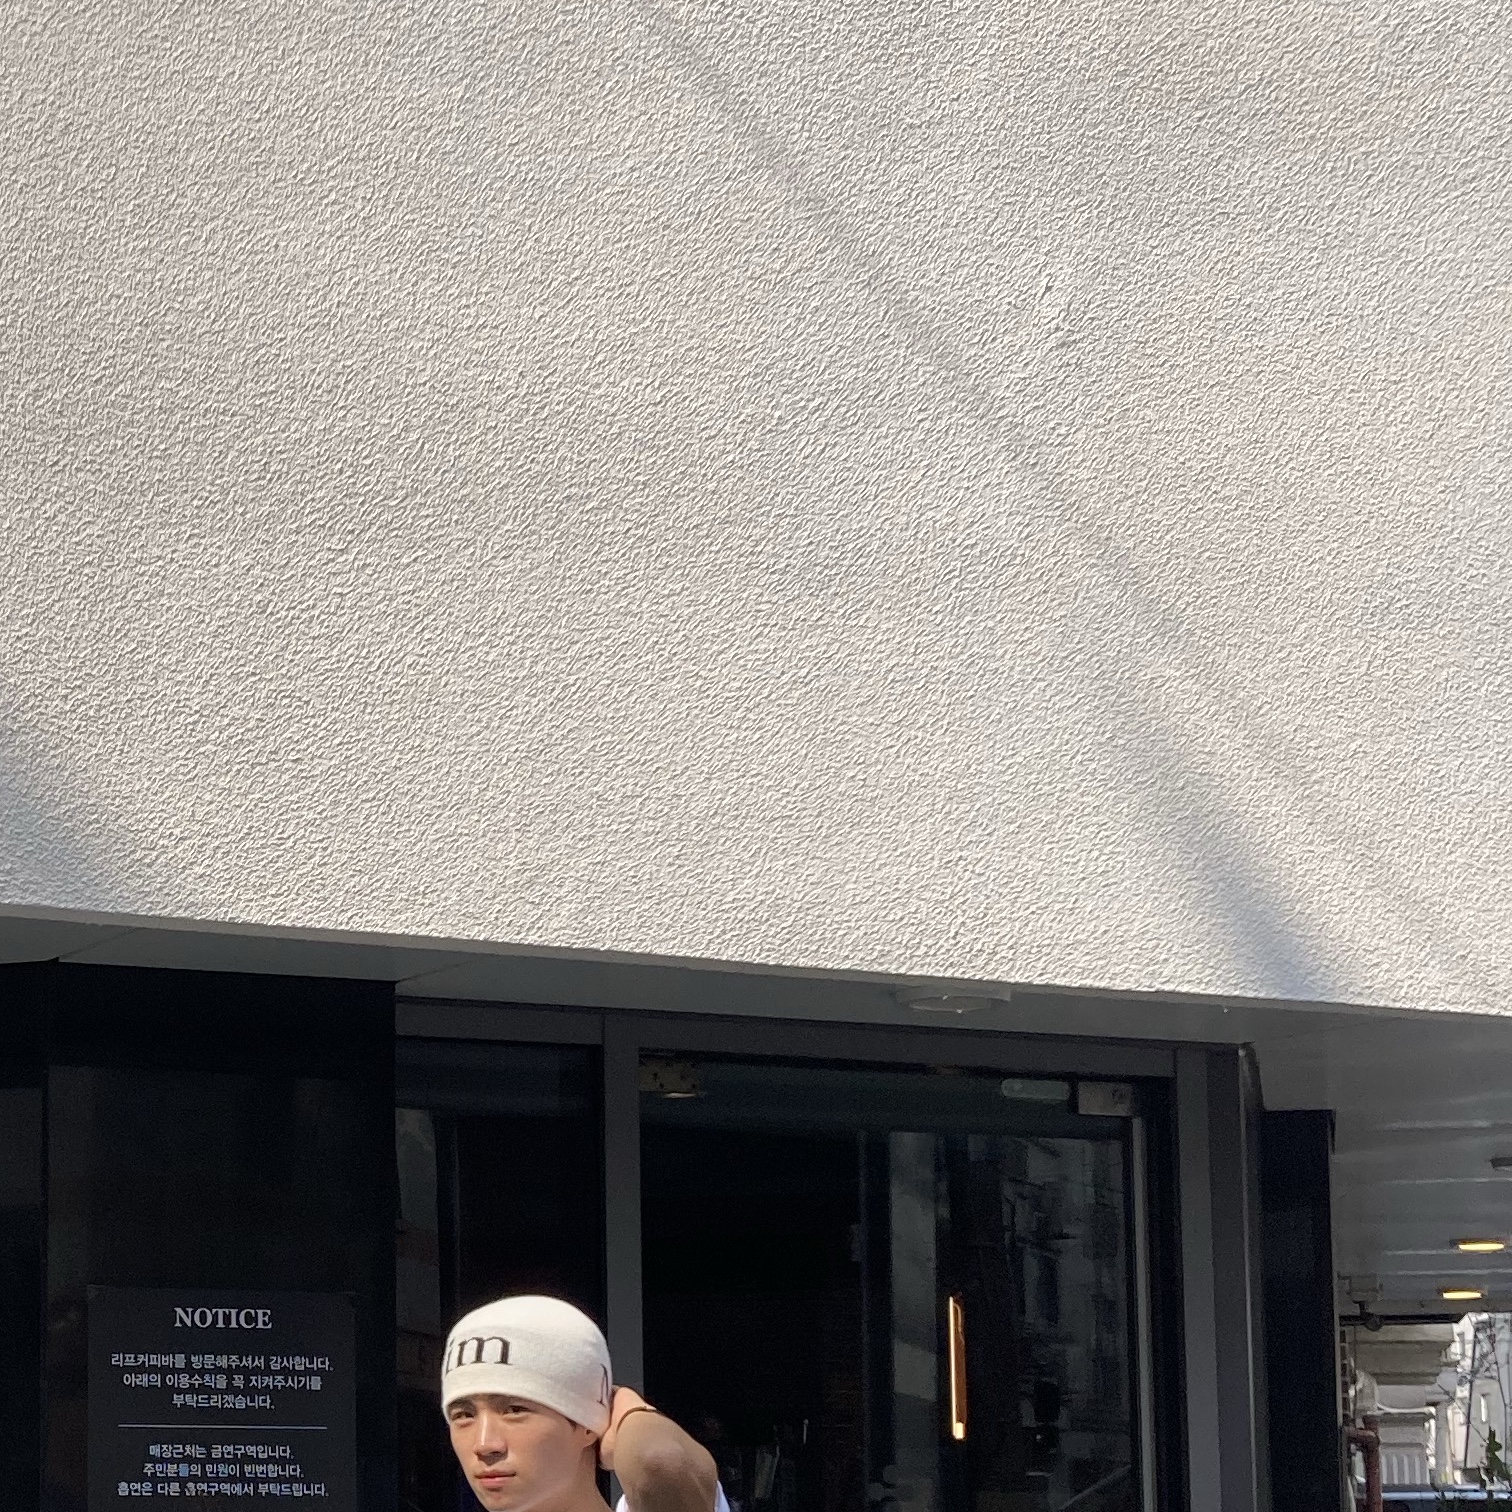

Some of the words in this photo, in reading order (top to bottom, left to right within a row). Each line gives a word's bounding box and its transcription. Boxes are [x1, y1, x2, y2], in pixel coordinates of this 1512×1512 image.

[173, 1307, 273, 1330] NOTICE
[110, 1353, 187, 1368] 리프커피바를
[190, 1354, 265, 1370] 방문해주셔서
[269, 1355, 335, 1372] 감사합니다.
[123, 1373, 162, 1388] 아래의
[166, 1373, 228, 1390] 이용수칙을
[232, 1374, 245, 1389] 꼭
[248, 1374, 323, 1391] 지켜주시기를
[171, 1393, 276, 1410] 부탁드리겠습니다.
[149, 1444, 207, 1459] 매장근처는
[210, 1444, 295, 1460] 금연구역입니다.
[143, 1463, 201, 1478] 주민분들의
[205, 1463, 240, 1478] 민원이
[243, 1463, 305, 1479] 빈번합니다.
[117, 1481, 153, 1496] 흡연은
[157, 1481, 181, 1496] 다른
[257, 1482, 330, 1497] 부탁드립니다.
